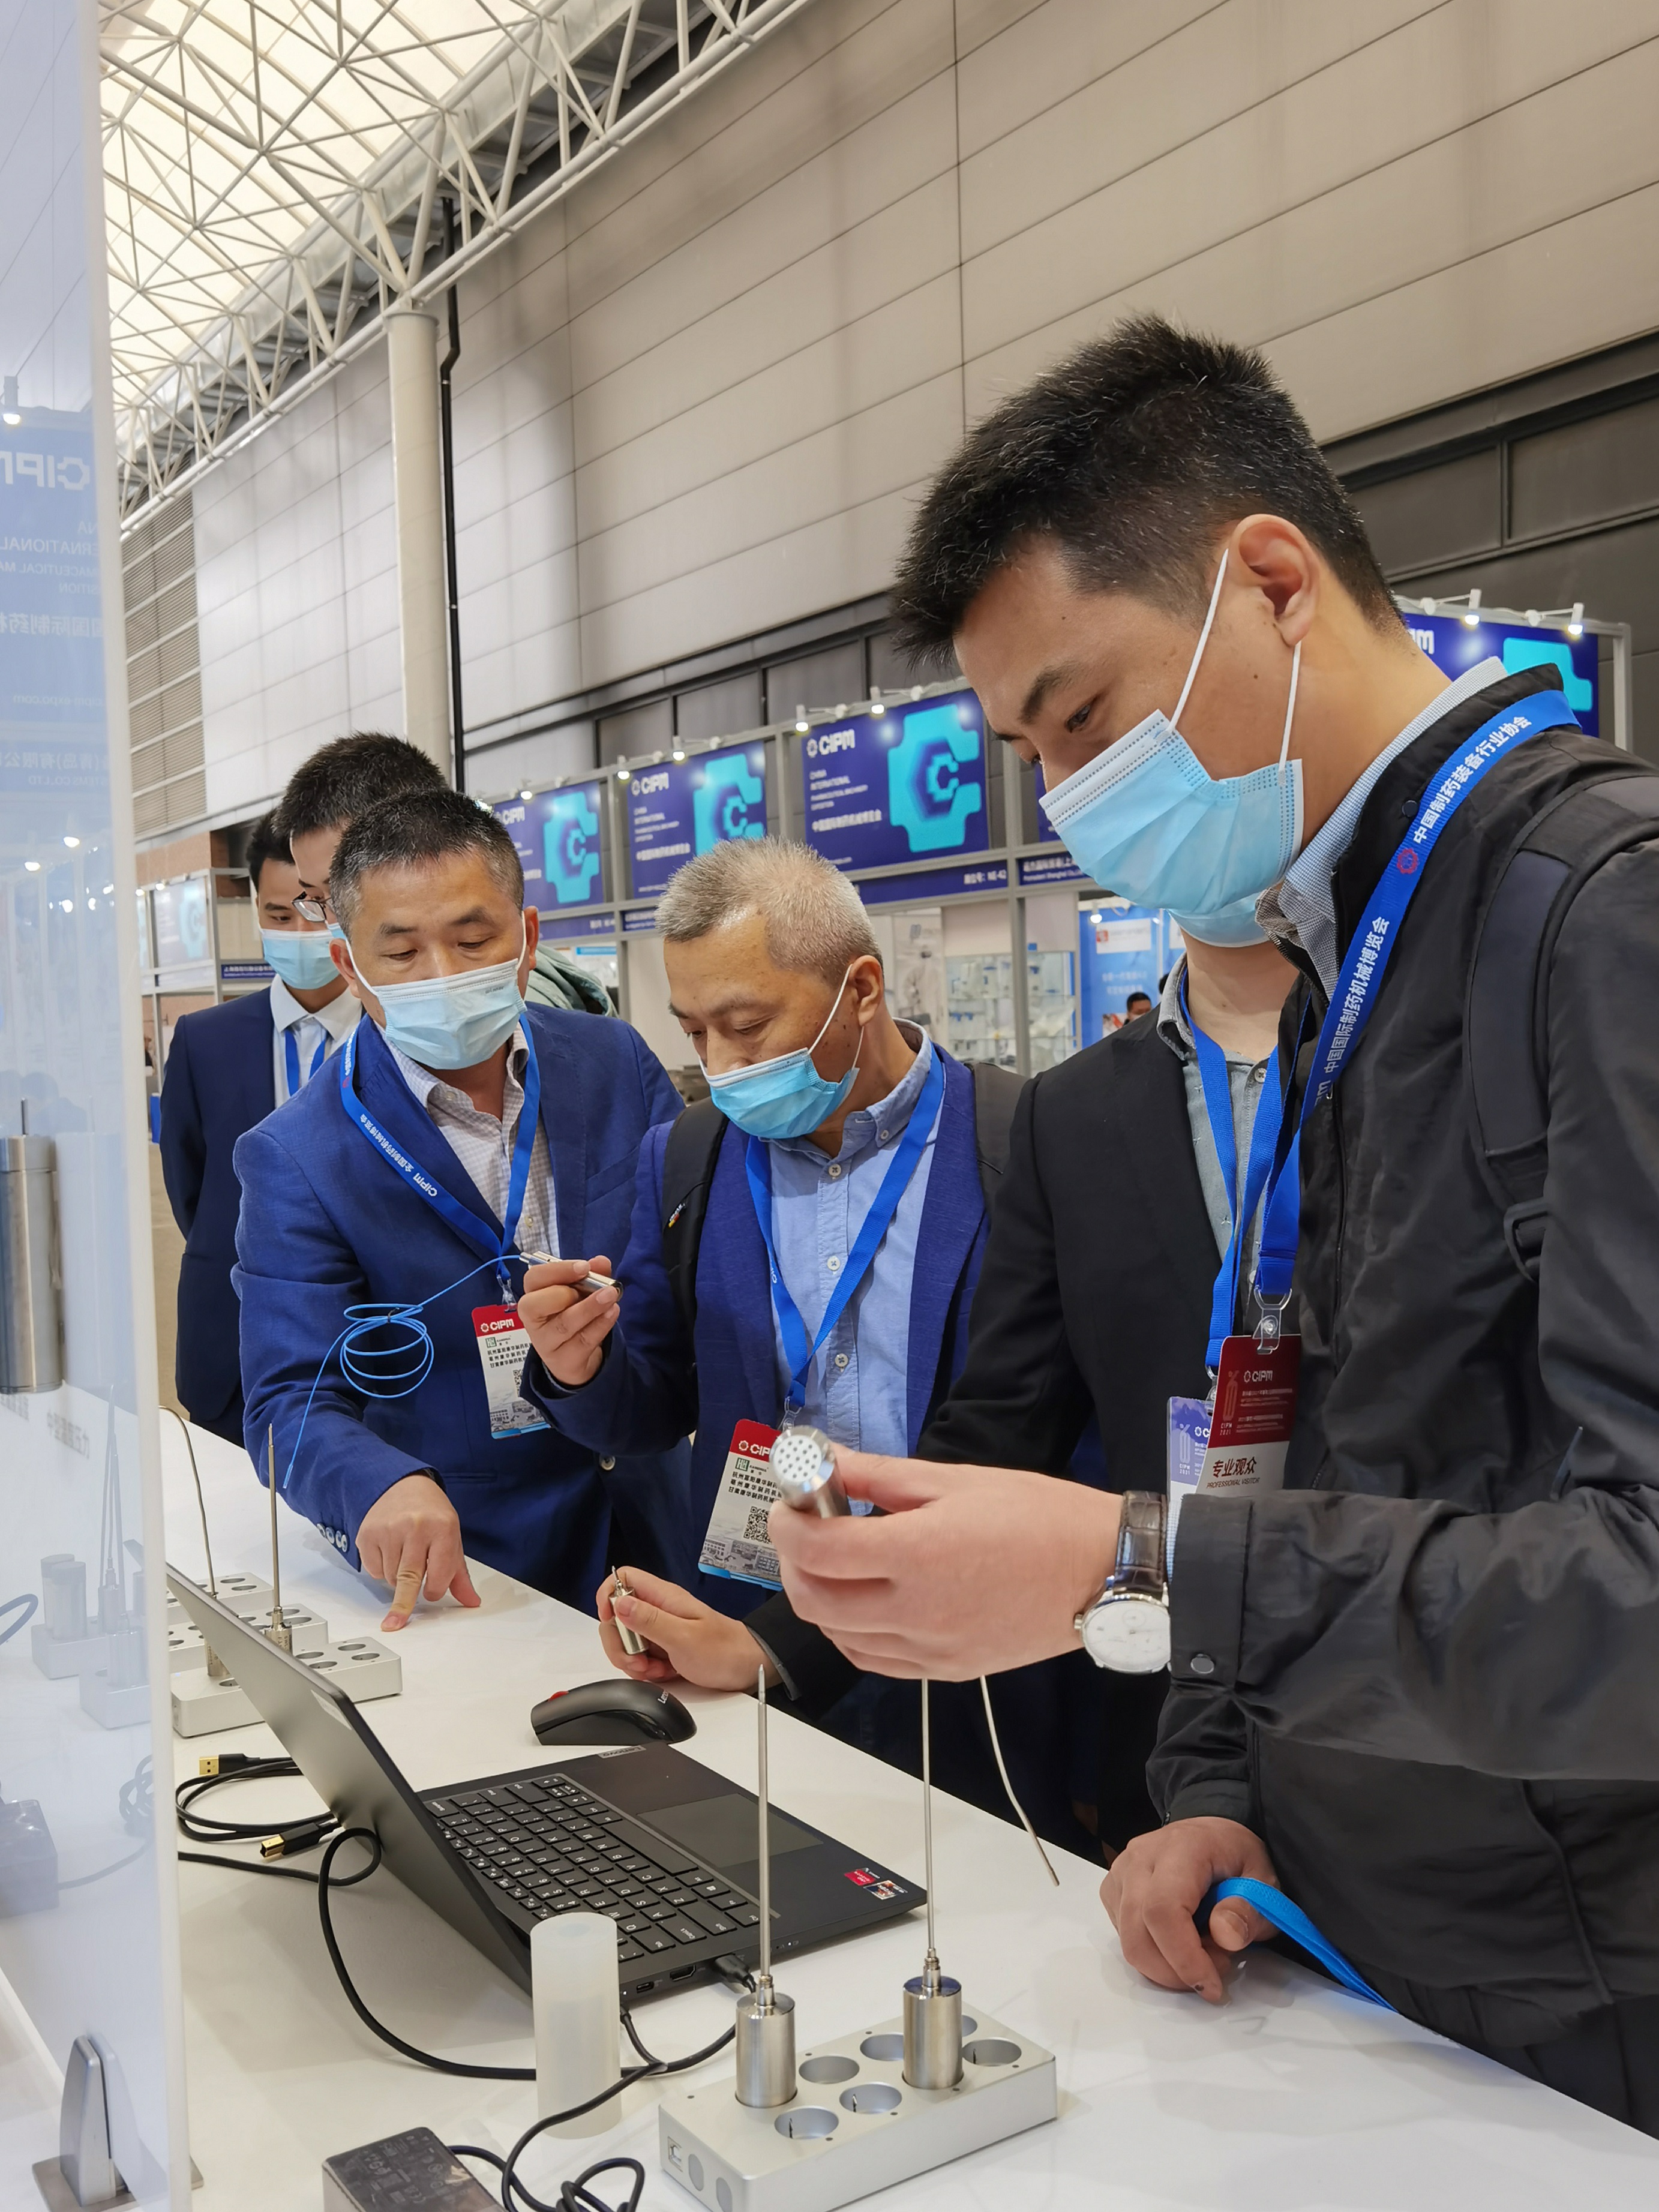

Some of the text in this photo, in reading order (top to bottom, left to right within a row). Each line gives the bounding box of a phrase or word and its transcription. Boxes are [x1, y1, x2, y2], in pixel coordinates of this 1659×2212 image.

[1413, 715, 1532, 844] 中国制药装备行业协会
[1324, 916, 1390, 1074] 中国国际制药机械博览会
[413, 1172, 437, 1197] CIPM
[490, 1318, 515, 1331] CIPM
[1252, 1370, 1273, 1382] CIPM
[1213, 1456, 1257, 1478] 专业观众
